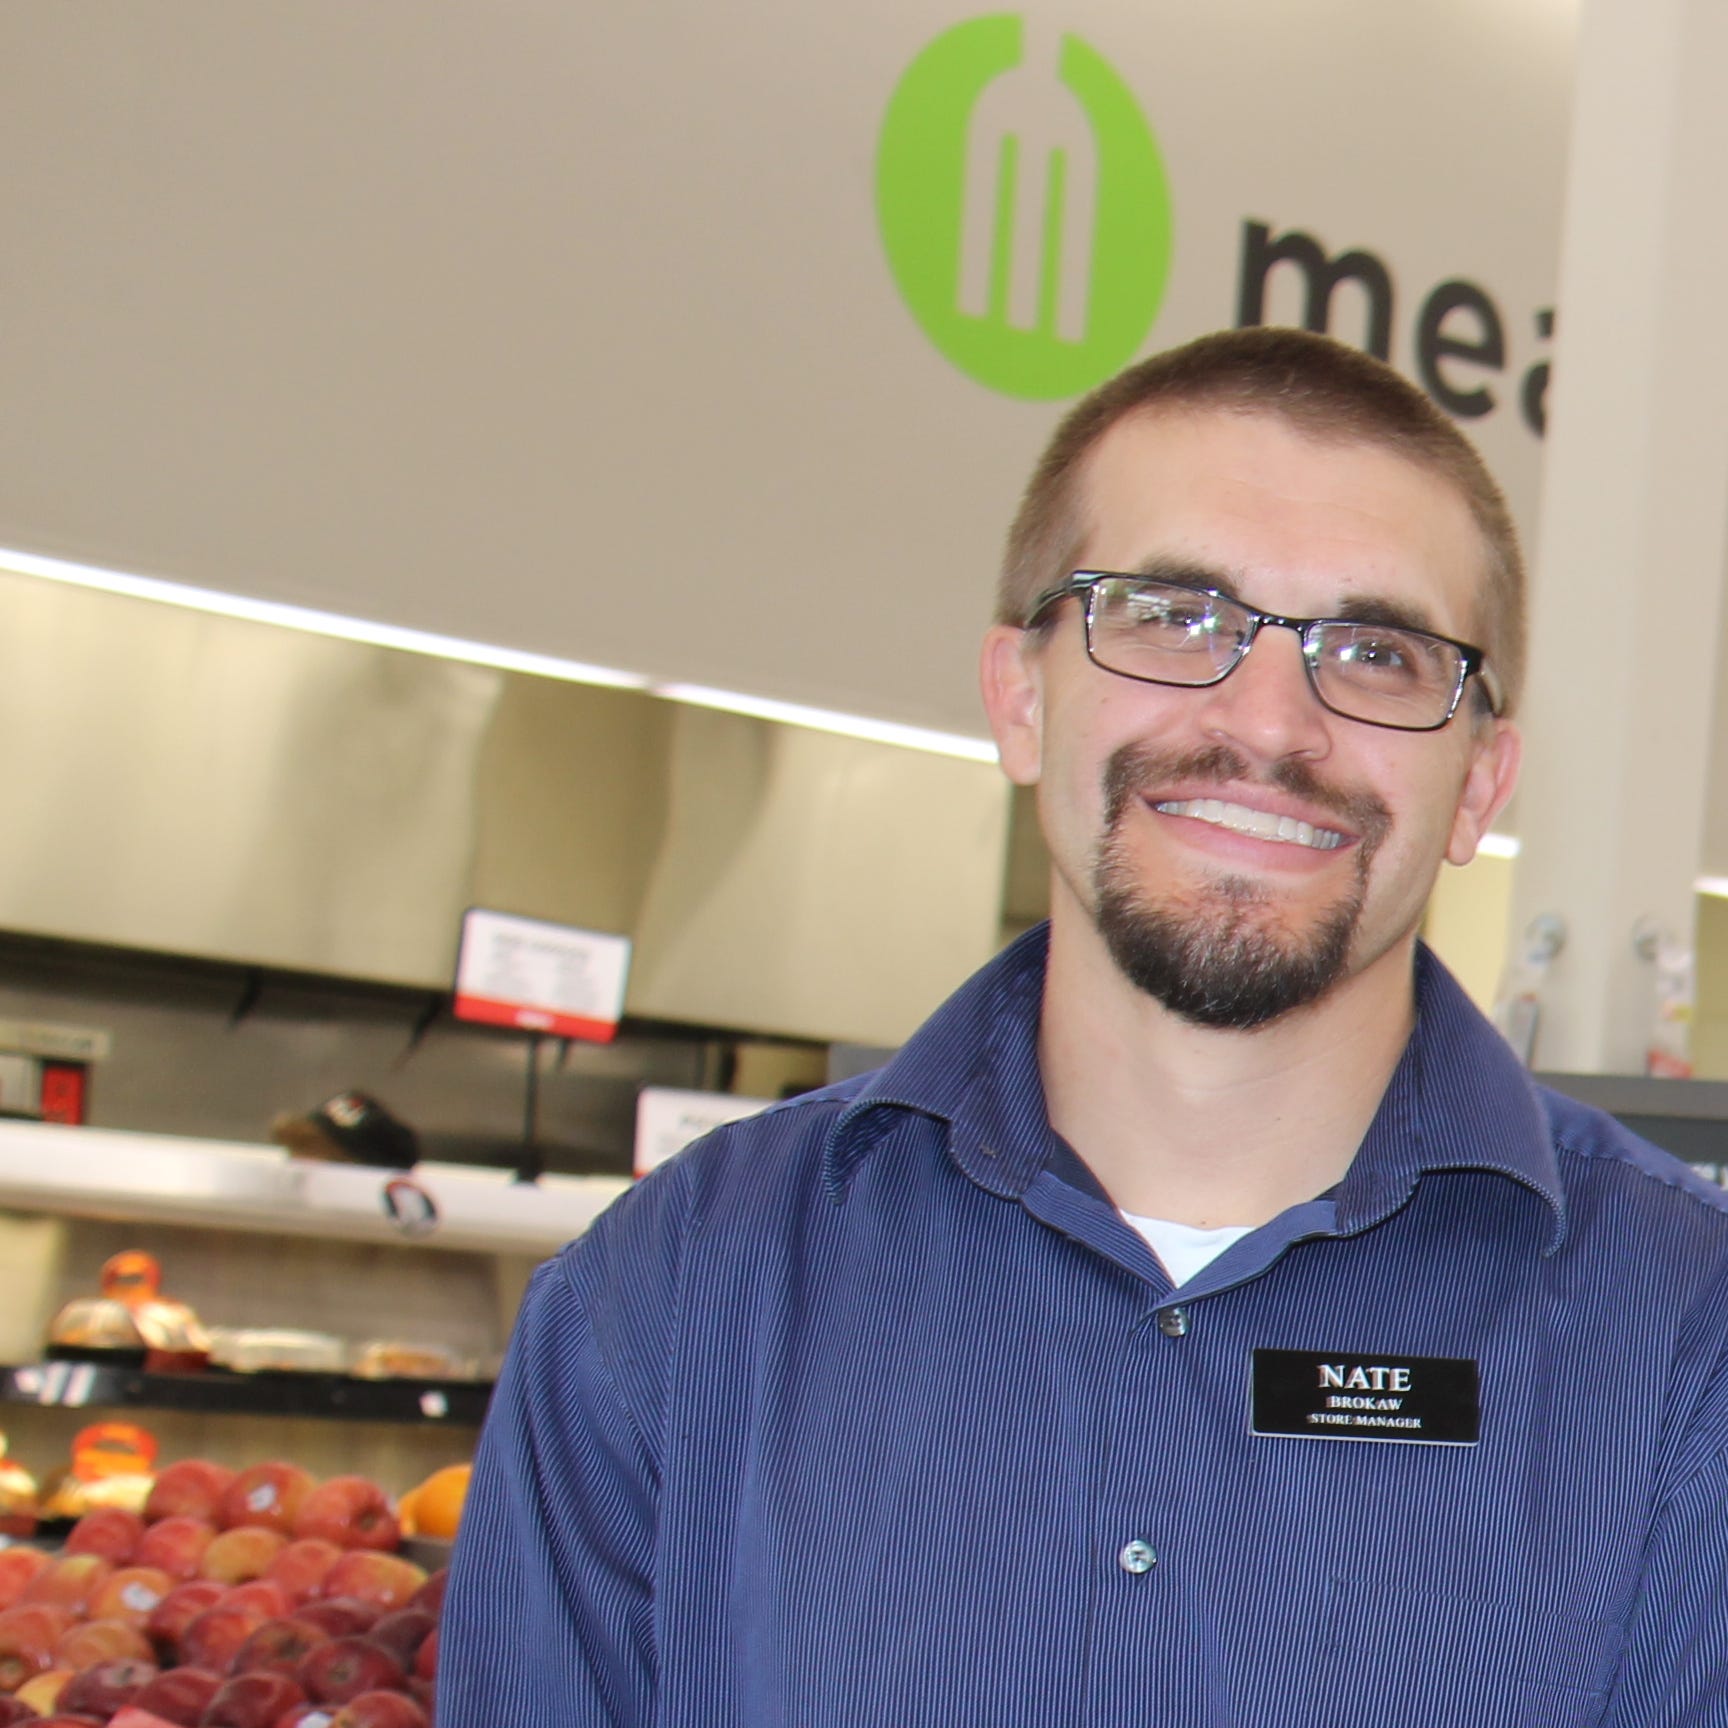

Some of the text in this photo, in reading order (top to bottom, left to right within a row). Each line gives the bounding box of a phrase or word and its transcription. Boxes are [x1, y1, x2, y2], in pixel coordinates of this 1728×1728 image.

[1317, 1364, 1412, 1392] NATE
[1326, 1395, 1403, 1411] BROKAW
[1308, 1412, 1422, 1429] STORE MANAGER
